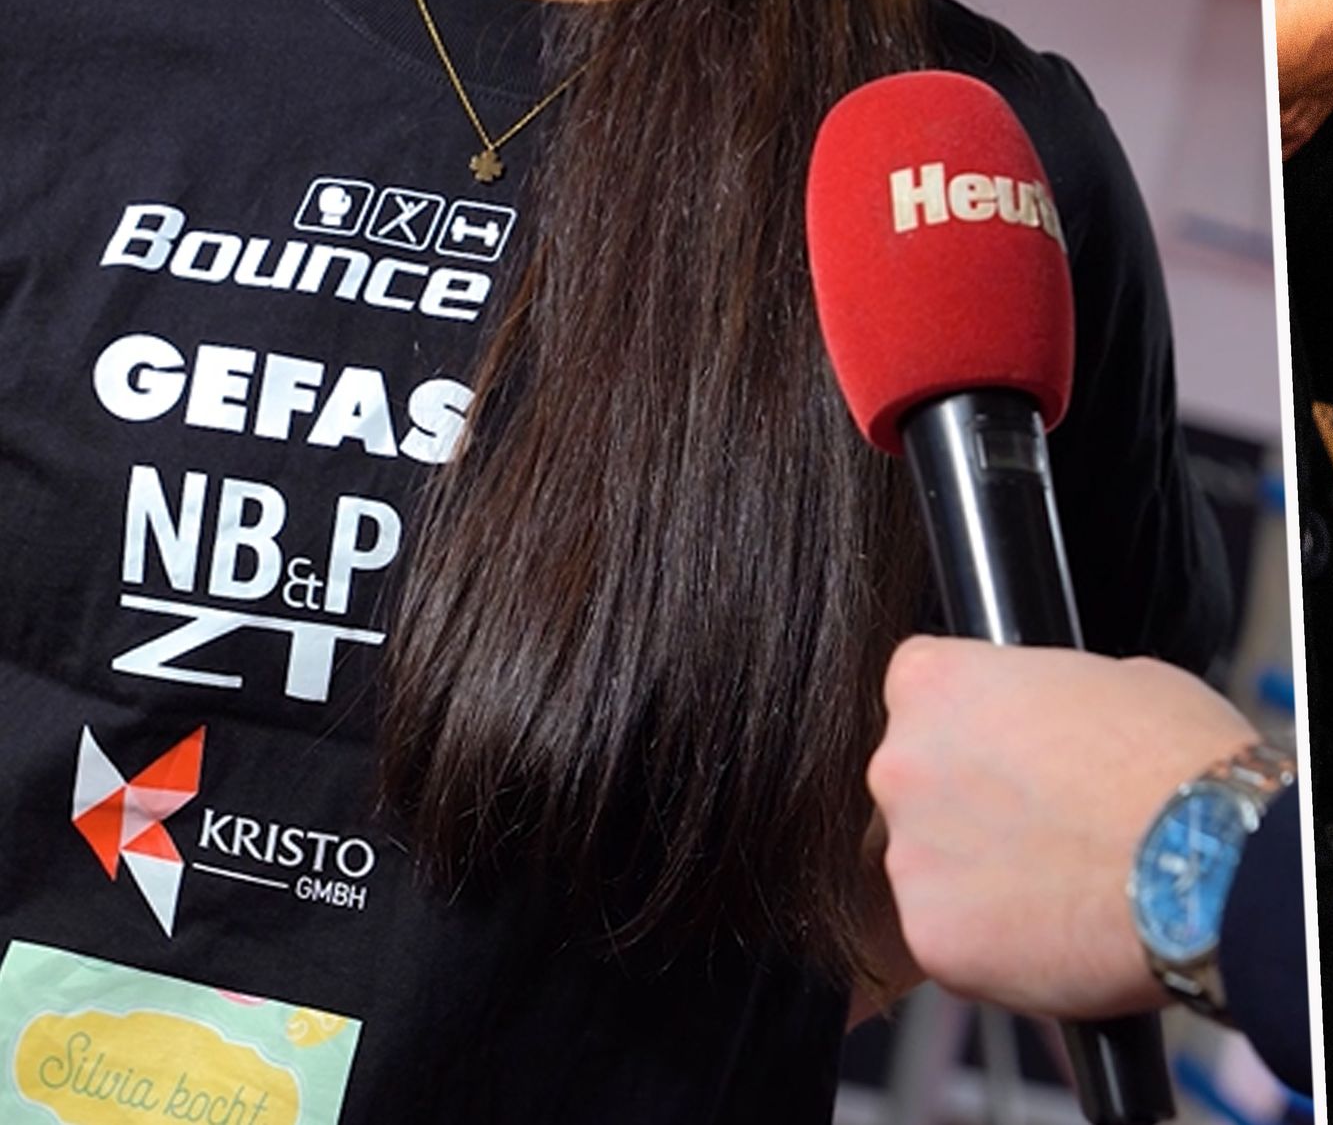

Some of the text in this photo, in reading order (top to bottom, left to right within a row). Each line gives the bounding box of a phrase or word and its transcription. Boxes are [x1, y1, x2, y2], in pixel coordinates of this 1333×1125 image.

[100, 203, 492, 321] Bounce
[93, 333, 476, 465] GEFAS
[120, 464, 402, 613] NB&P
[111, 594, 386, 702] ZT
[199, 808, 376, 878] KRISTO
[294, 876, 367, 911] GMBH
[38, 1030, 270, 1125] Silvia kocht
